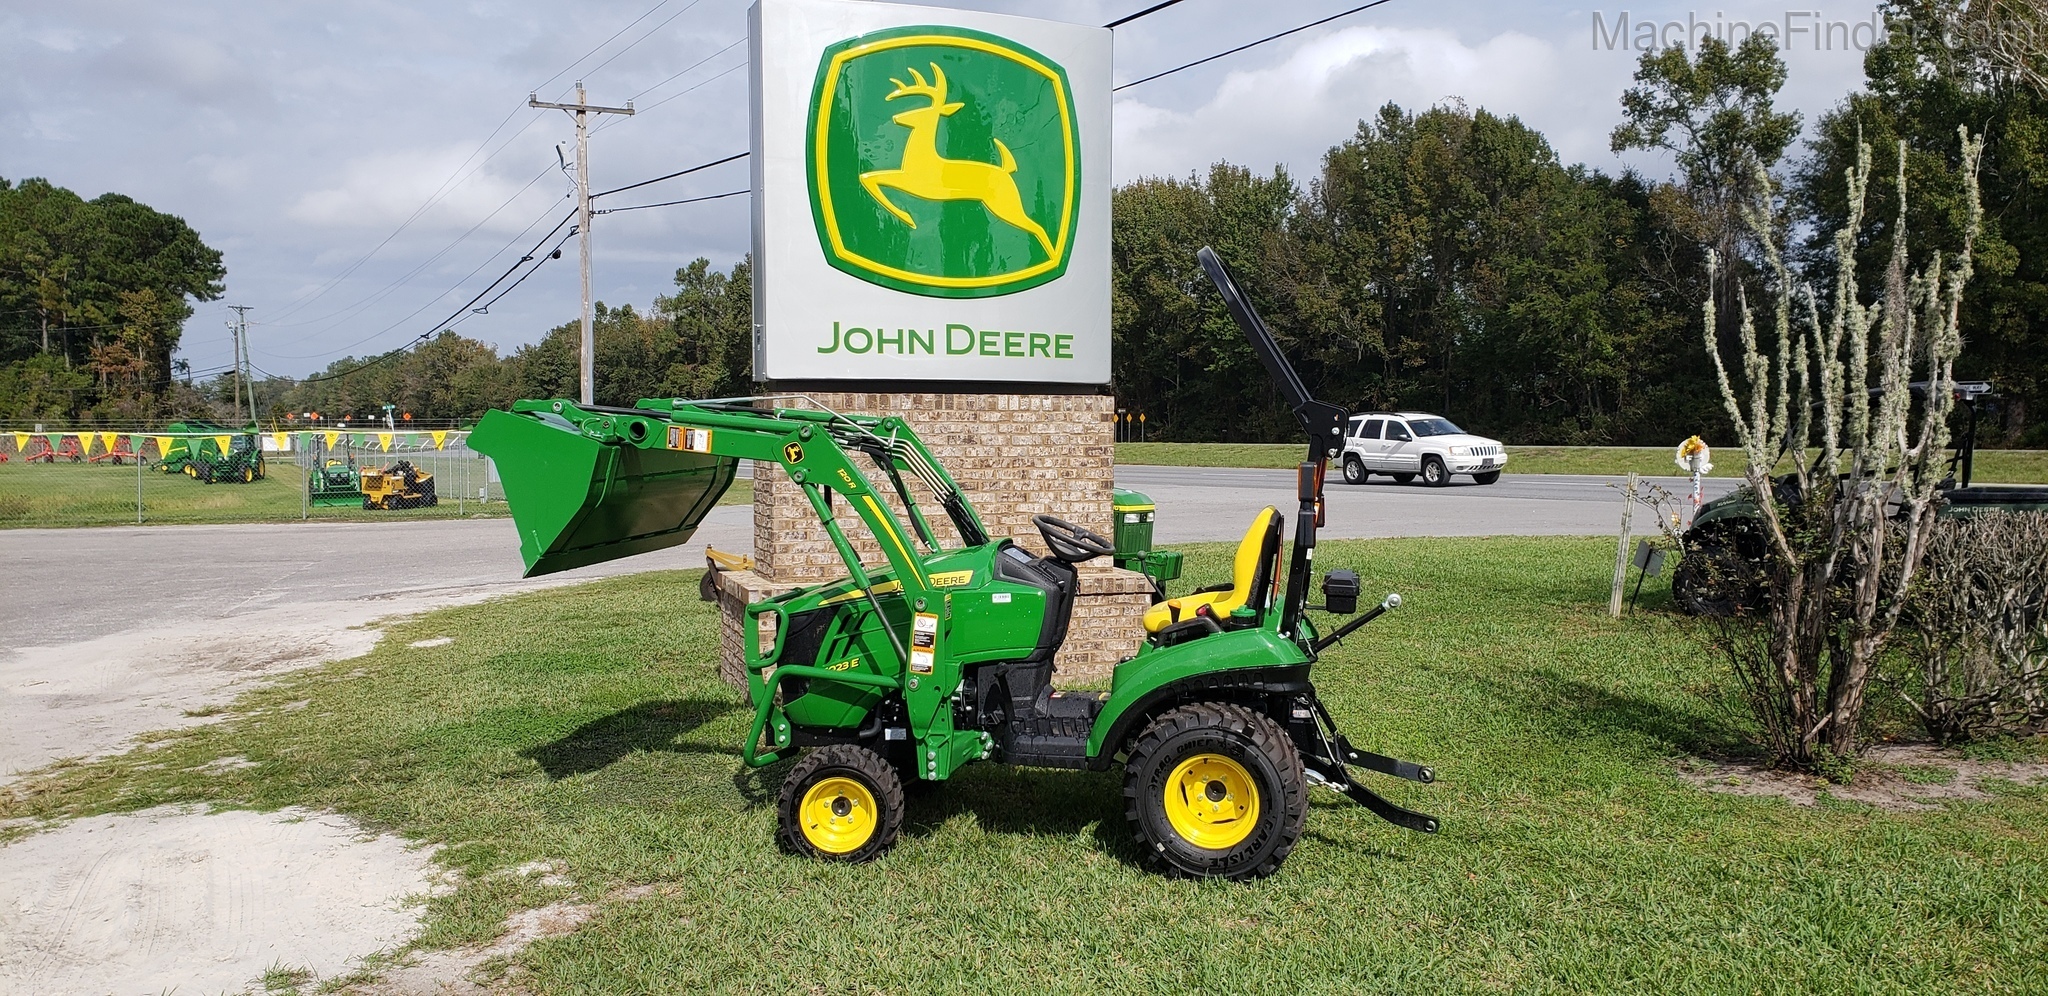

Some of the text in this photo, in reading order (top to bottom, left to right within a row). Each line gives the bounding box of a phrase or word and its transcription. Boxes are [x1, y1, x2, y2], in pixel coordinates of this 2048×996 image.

[817, 321, 1074, 359] JOHN DEERE
[931, 576, 966, 586] DEERE
[1177, 739, 1213, 754] CHIEF
[1209, 818, 1274, 867] CARLISLE
